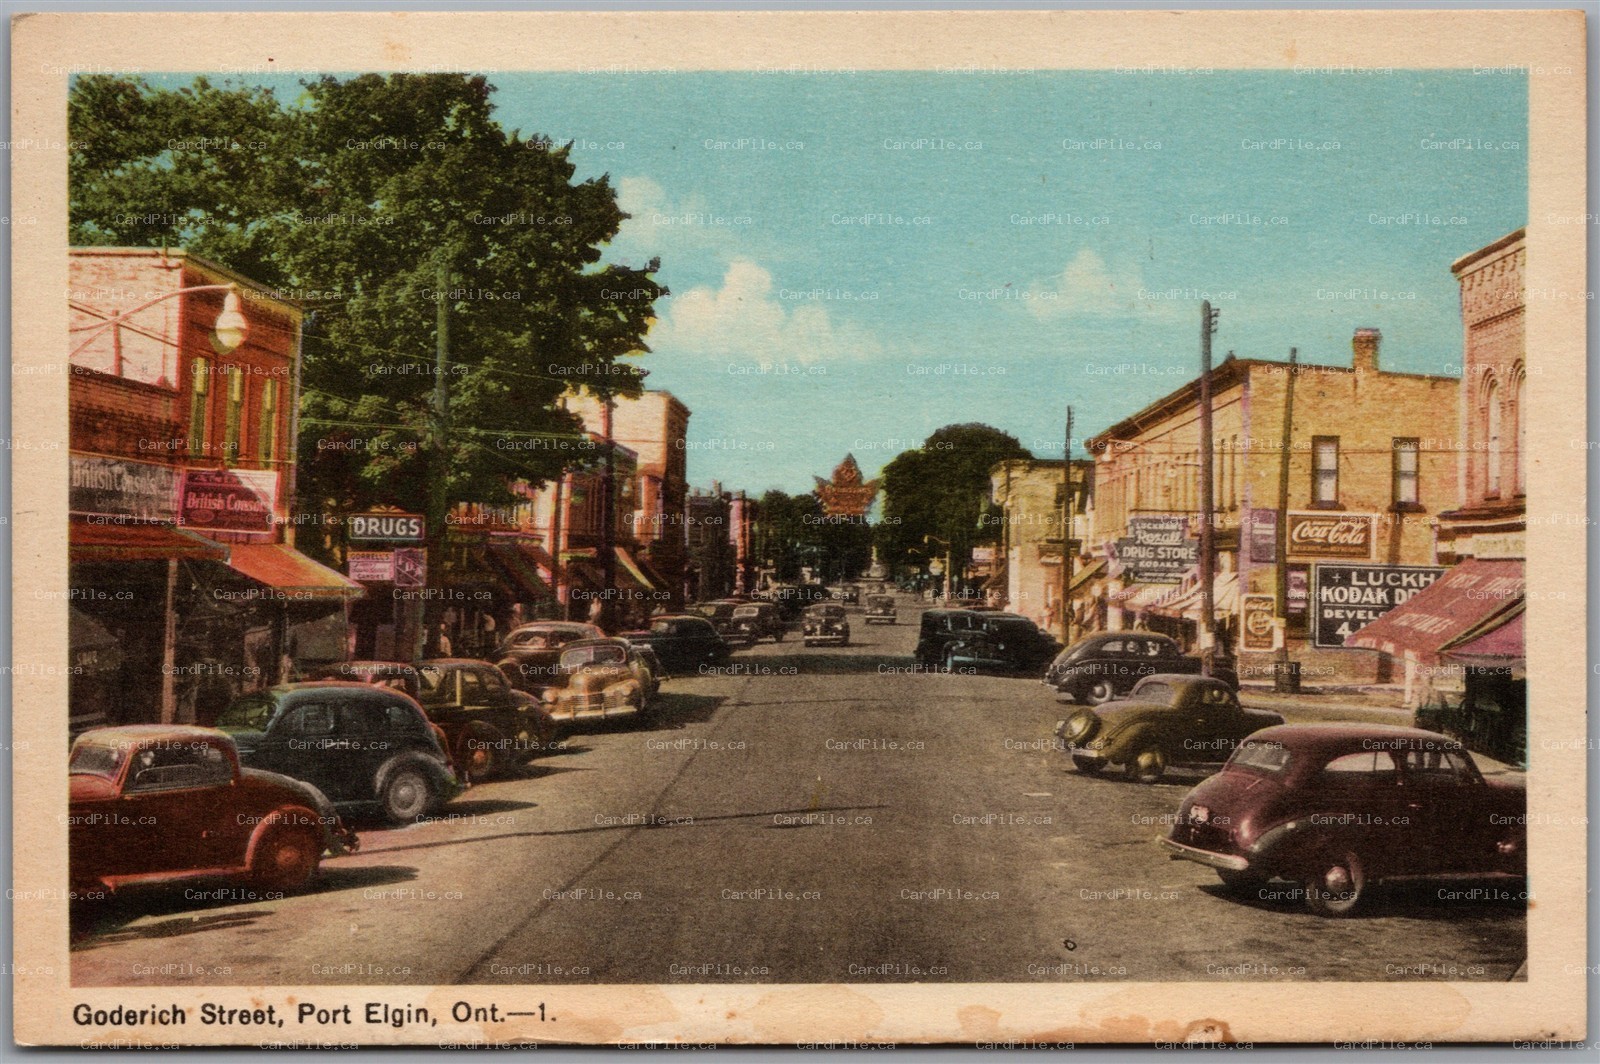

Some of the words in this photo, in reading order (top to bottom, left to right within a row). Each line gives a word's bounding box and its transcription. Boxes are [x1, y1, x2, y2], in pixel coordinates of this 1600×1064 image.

[187, 491, 225, 511] British
[354, 517, 420, 536] DRUGS
[1135, 530, 1183, 545] Rexall
[1122, 546, 1155, 559] DRUG
[1157, 547, 1196, 559] STORE
[1351, 571, 1435, 588] LUCKH
[1321, 586, 1389, 604] KODAK
